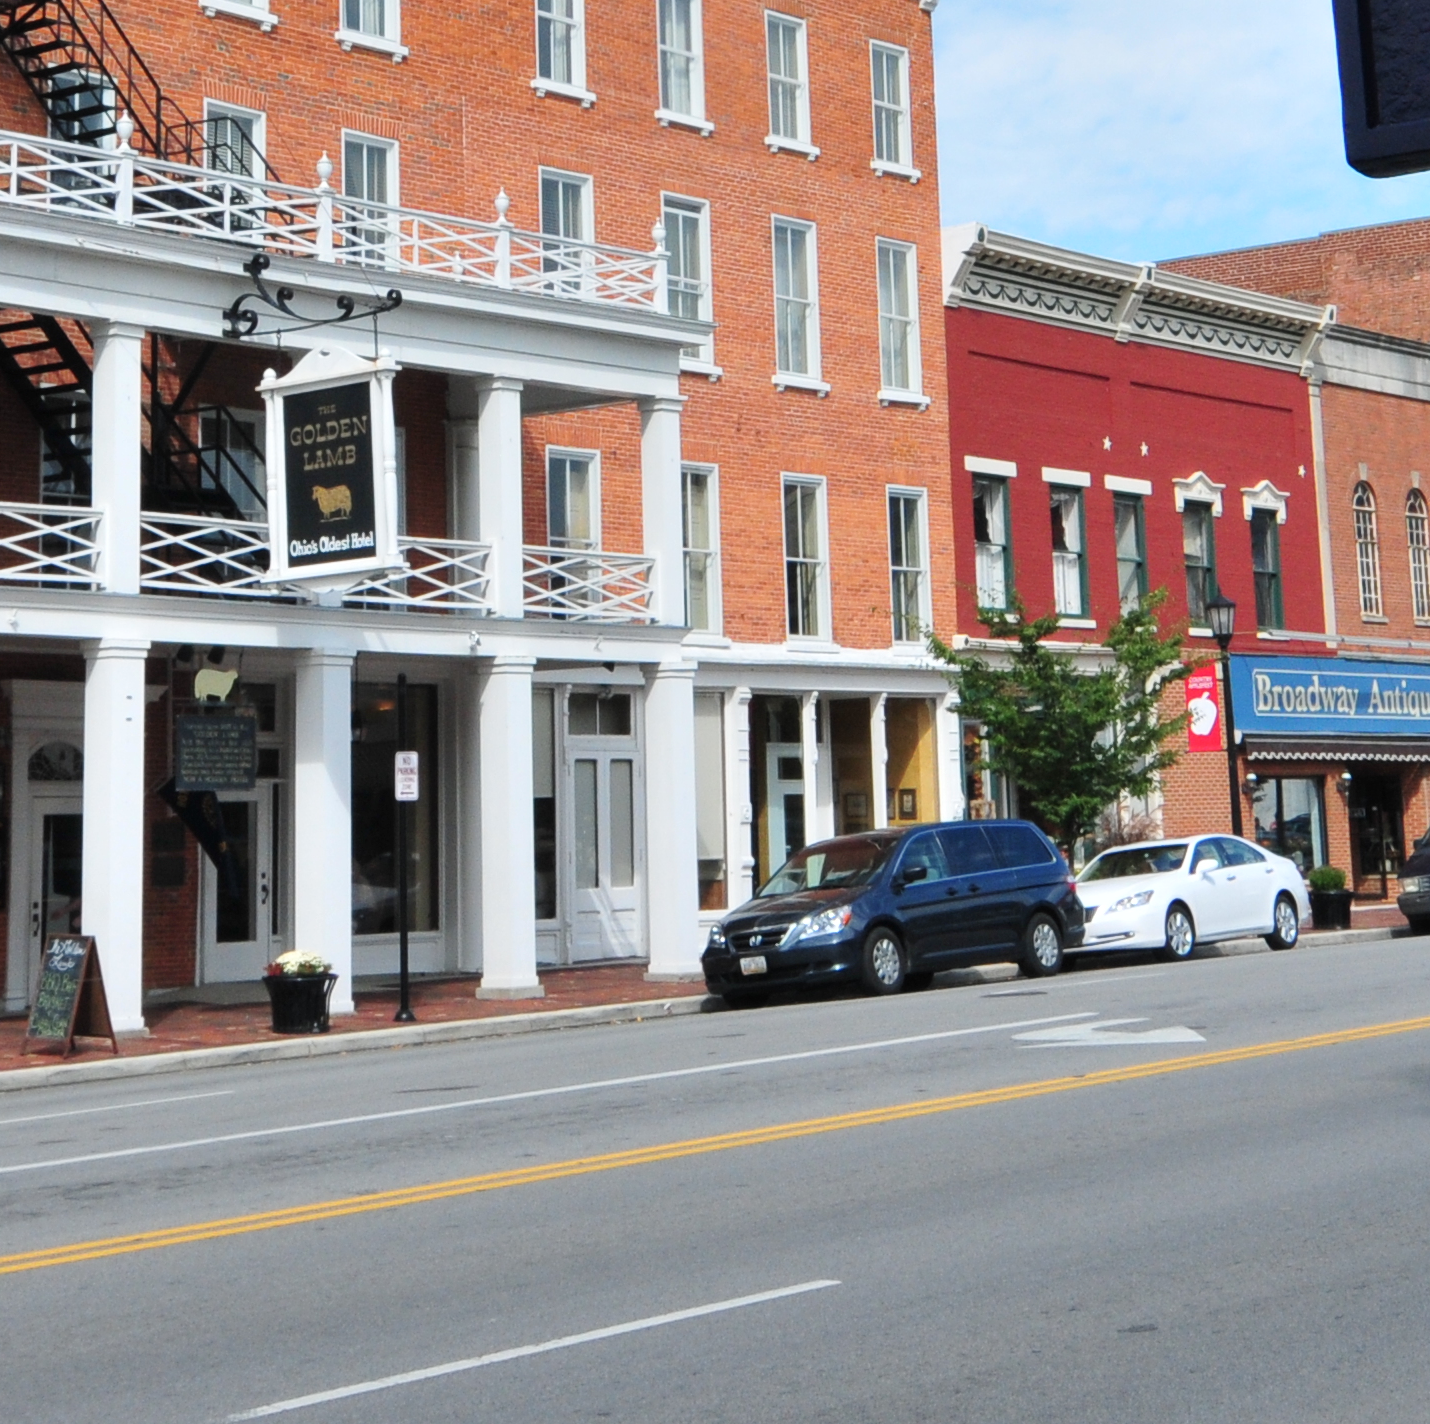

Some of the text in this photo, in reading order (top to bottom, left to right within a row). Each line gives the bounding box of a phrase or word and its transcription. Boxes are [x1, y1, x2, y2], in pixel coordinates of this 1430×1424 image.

[318, 404, 336, 415] THE
[290, 415, 368, 447] GOLDEN
[303, 445, 357, 471] LAMB
[289, 531, 374, 557] Ohio's Oldest Hotel
[1255, 674, 1359, 716] Broadway
[402, 756, 411, 766] NO
